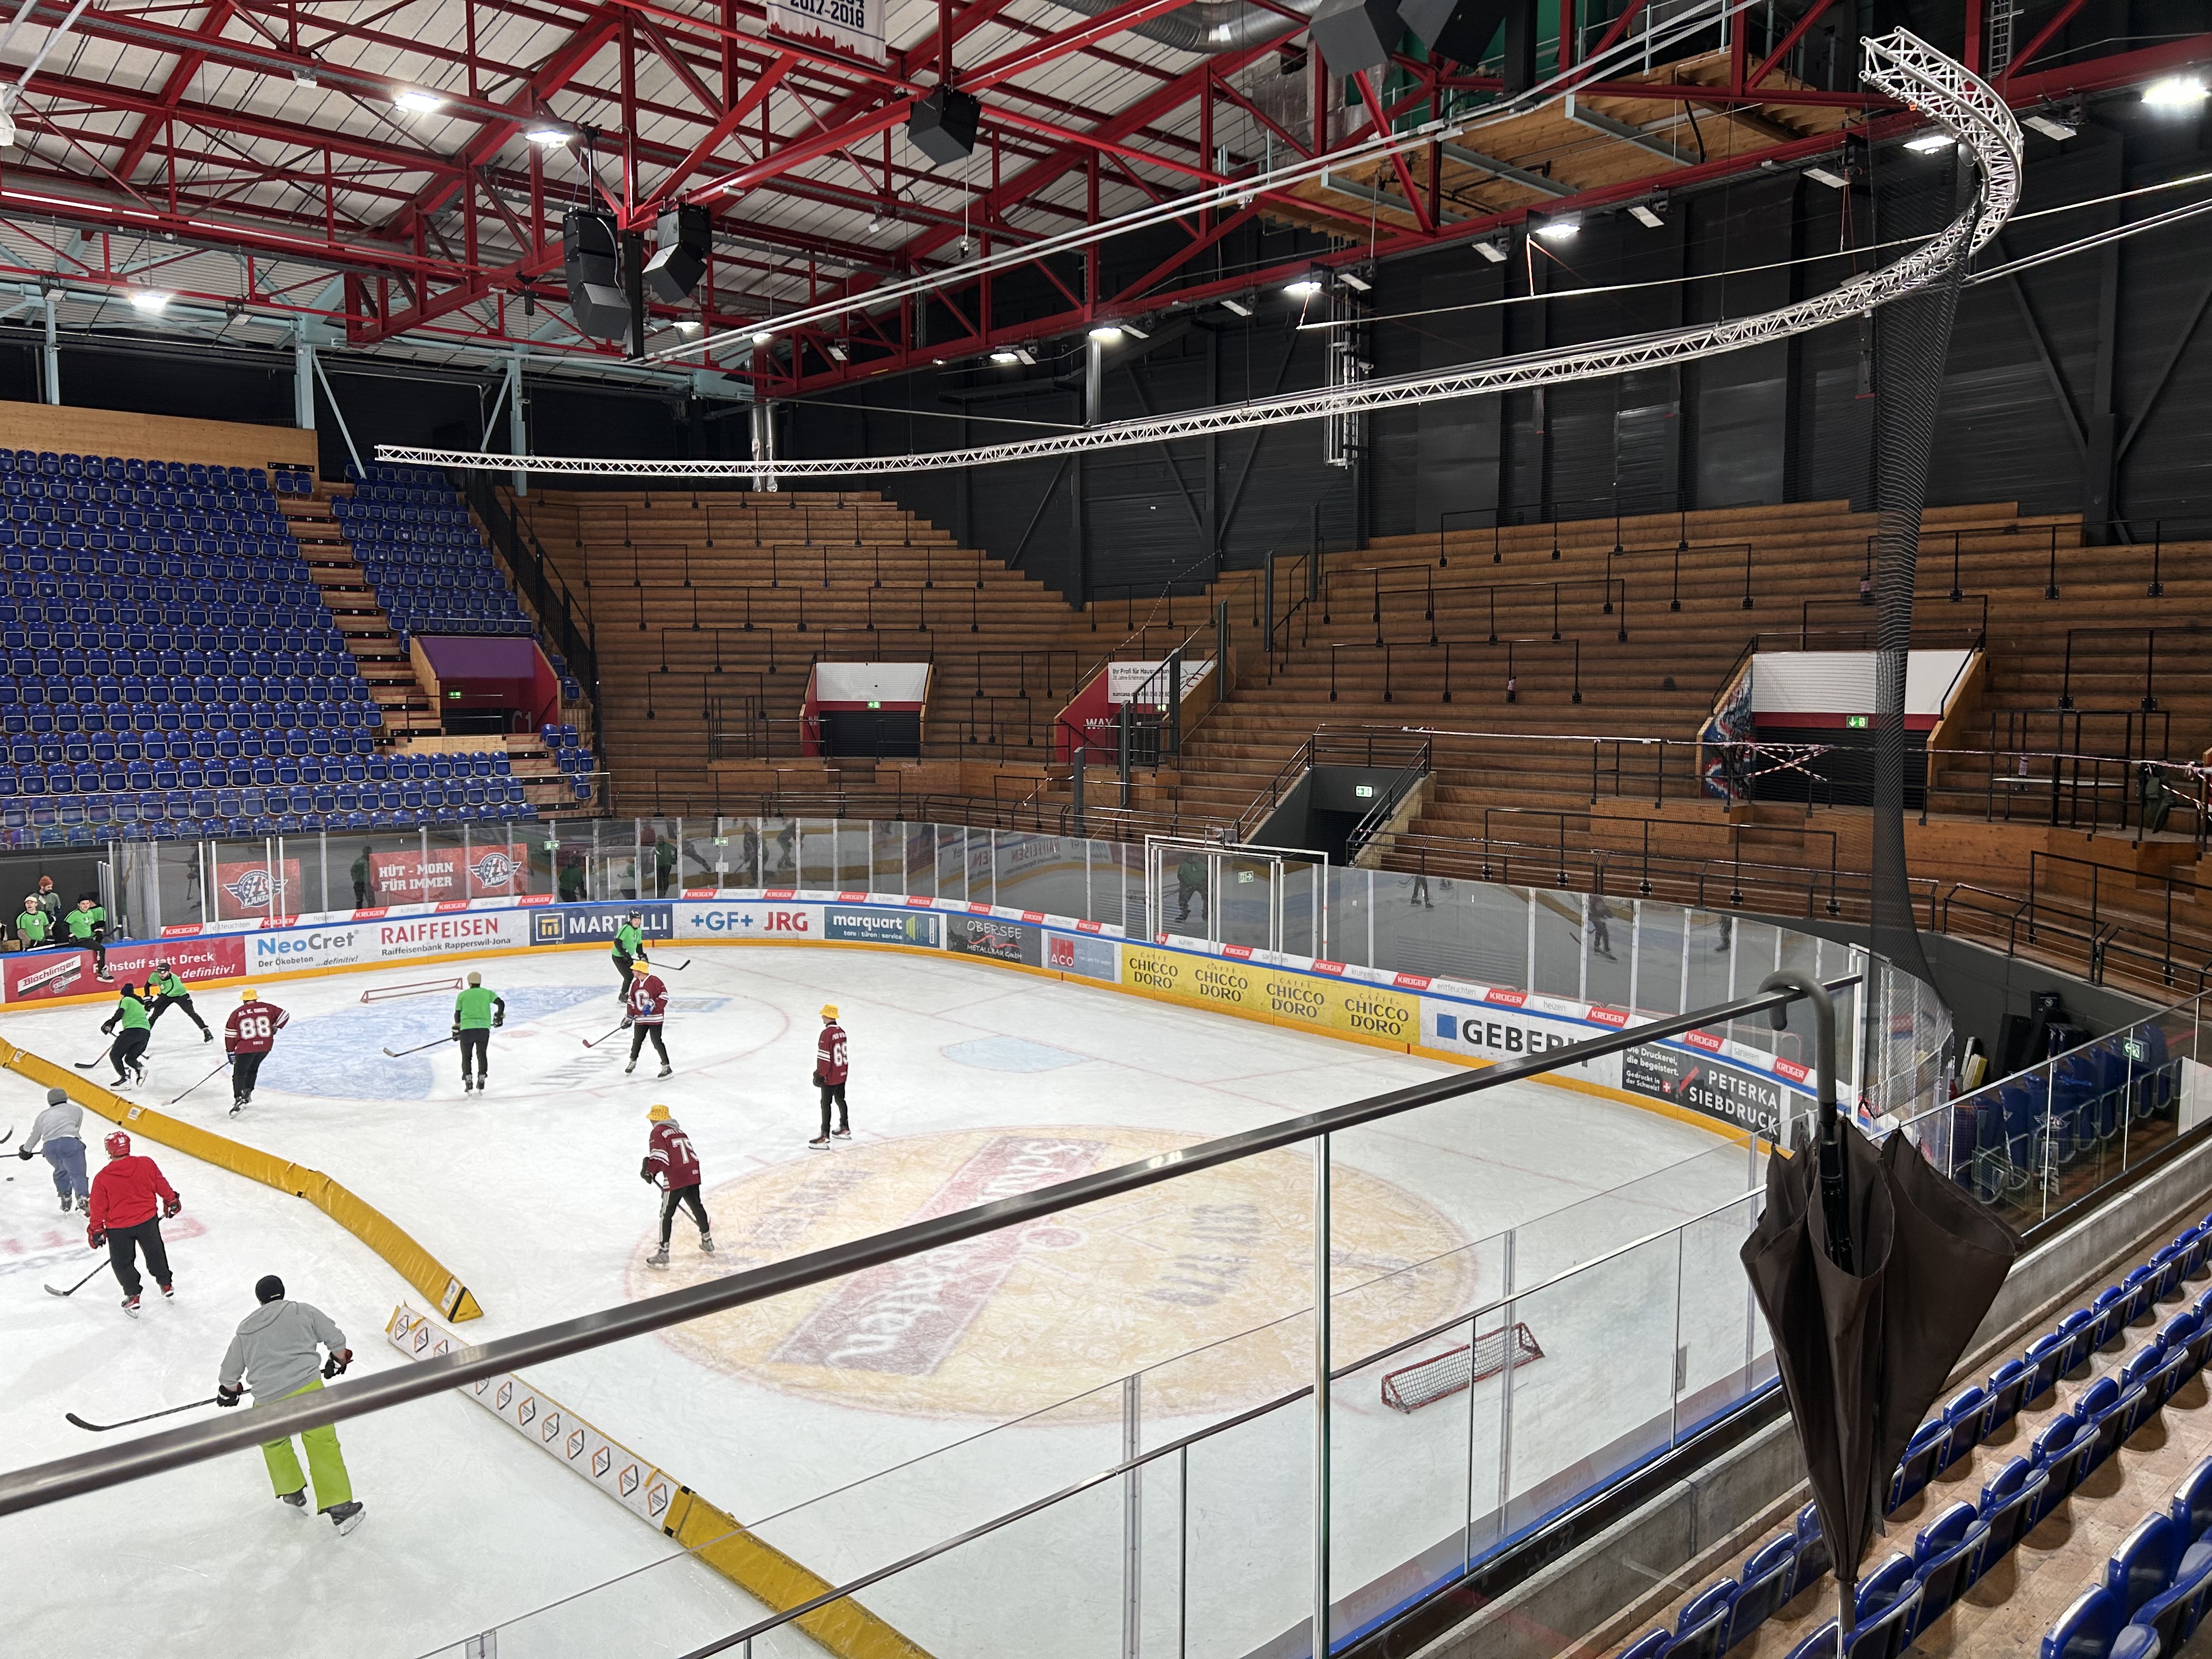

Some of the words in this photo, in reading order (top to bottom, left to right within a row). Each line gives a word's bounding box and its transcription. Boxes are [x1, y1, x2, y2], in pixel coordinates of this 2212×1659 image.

[512, 709, 532, 733] C1
[1086, 718, 1113, 730] WAY
[379, 864, 405, 878] HÜT
[417, 862, 454, 875] MORN
[381, 878, 406, 892] FÜR
[410, 876, 453, 889] IMMER
[243, 894, 269, 907] LAKER
[212, 922, 250, 931] etfeuchten
[381, 917, 498, 945] RAIFFEISEN
[569, 913, 667, 934] MARTLLI
[764, 912, 808, 932] JRG
[833, 915, 902, 932] marquart
[967, 920, 1022, 940] OBERSEE
[382, 943, 442, 956] Raiffeisenbank
[445, 938, 511, 952] Rapperswil-Jona
[967, 944, 1005, 958] METALLBAU
[179, 952, 215, 964] Dreck
[275, 956, 313, 966] Ökobeton
[1051, 953, 1074, 967] ACO
[1130, 958, 1178, 977] CHICCO
[1195, 969, 1248, 990] CHICCO
[1266, 983, 1324, 1005] CHICCO
[1437, 983, 1476, 996] entfeuchten
[1345, 998, 1409, 1022] CHICCO
[1543, 1001, 1566, 1012] heizen
[239, 1015, 272, 1040] 88
[833, 1042, 849, 1067] 69
[1641, 1048, 1678, 1066] Druckerei,
[1734, 1046, 1759, 1062] sanieren
[1627, 1055, 1639, 1065] die
[1640, 1058, 1679, 1076] begeistert.
[1626, 1069, 1654, 1084] Gedruckt
[1654, 1076, 1660, 1084] in
[1626, 1076, 1636, 1085] der
[1708, 1069, 1778, 1110] PETERKA
[1689, 1086, 1778, 1136] SIEBDRUCK
